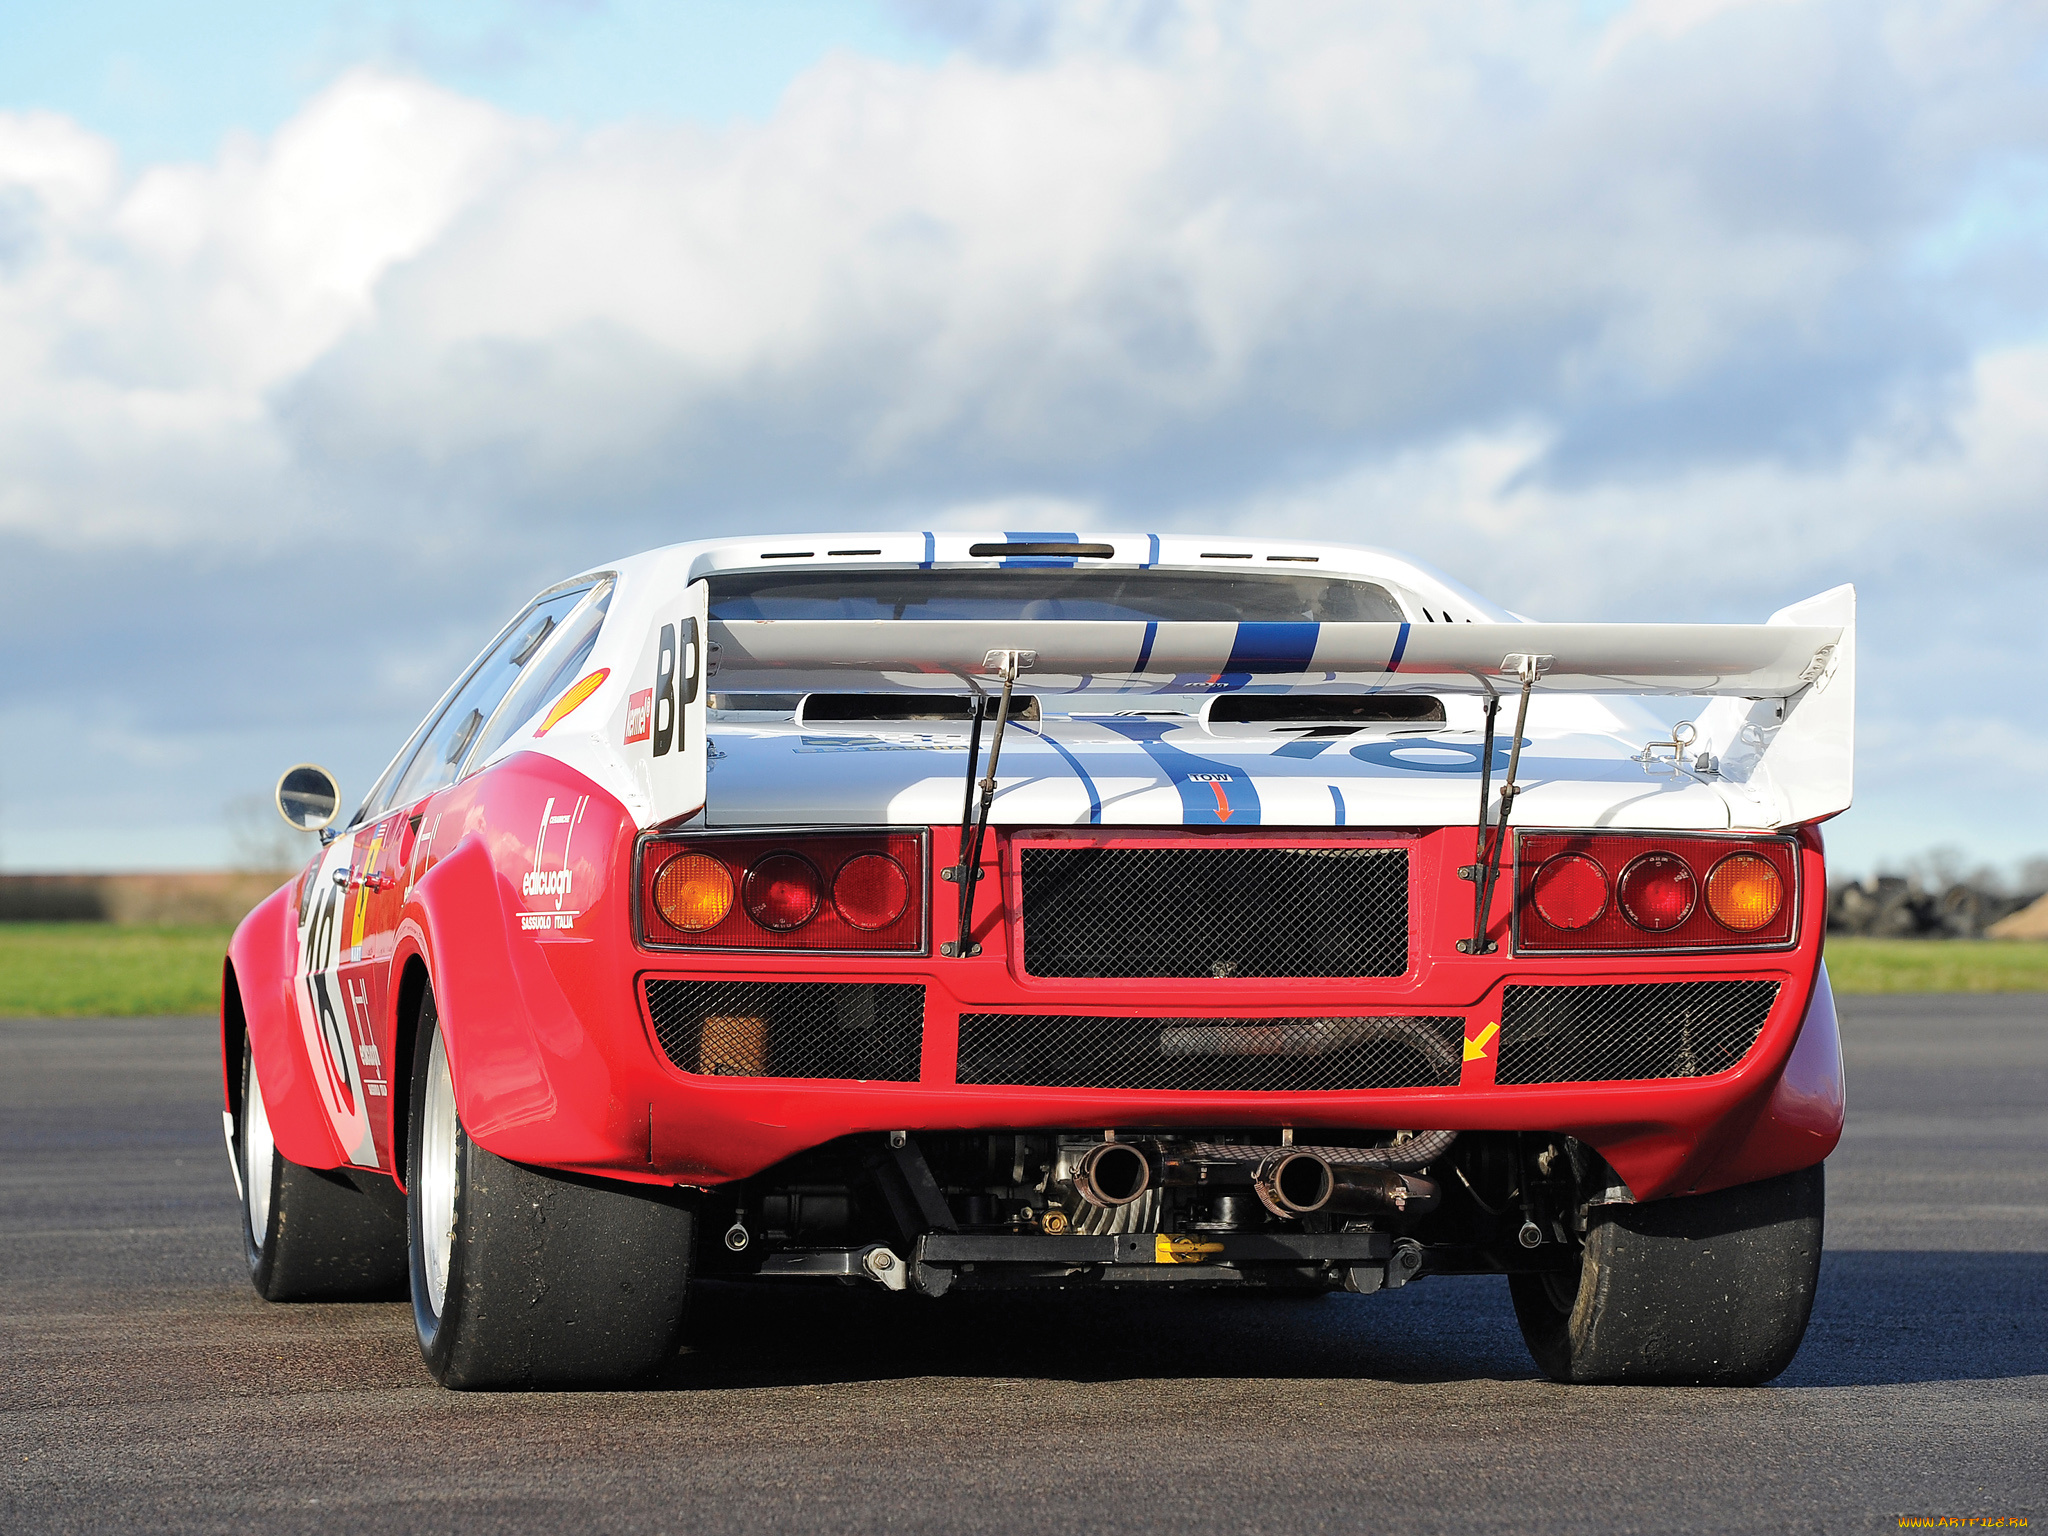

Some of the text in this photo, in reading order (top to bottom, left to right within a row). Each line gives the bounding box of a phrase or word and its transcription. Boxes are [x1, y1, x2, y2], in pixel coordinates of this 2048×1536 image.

[653, 616, 700, 757] BP
[1189, 773, 1229, 782] TOW
[521, 914, 574, 931] SASSUOLO ITALIA
